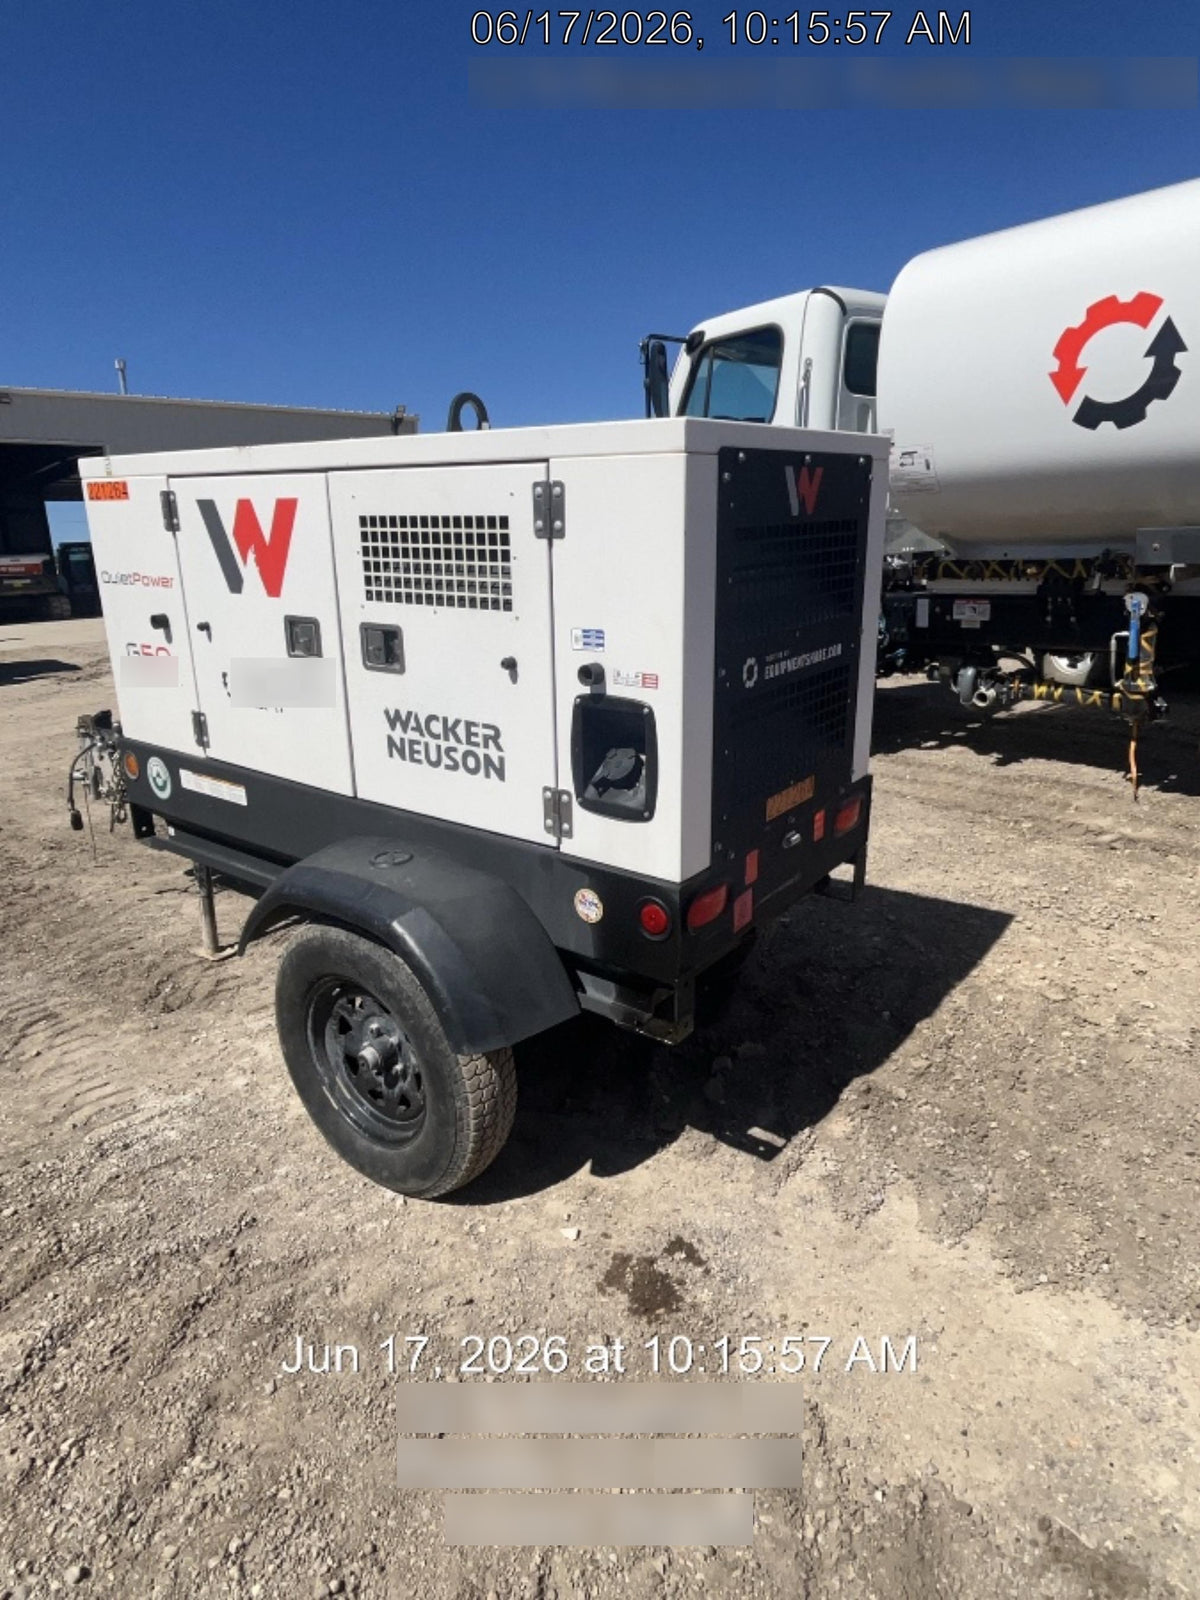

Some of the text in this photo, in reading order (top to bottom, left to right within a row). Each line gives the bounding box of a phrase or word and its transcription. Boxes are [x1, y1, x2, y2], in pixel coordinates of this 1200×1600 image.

[101, 571, 175, 588] QuietPower
[384, 708, 504, 752] WACKER
[387, 734, 506, 782] NEUSON
